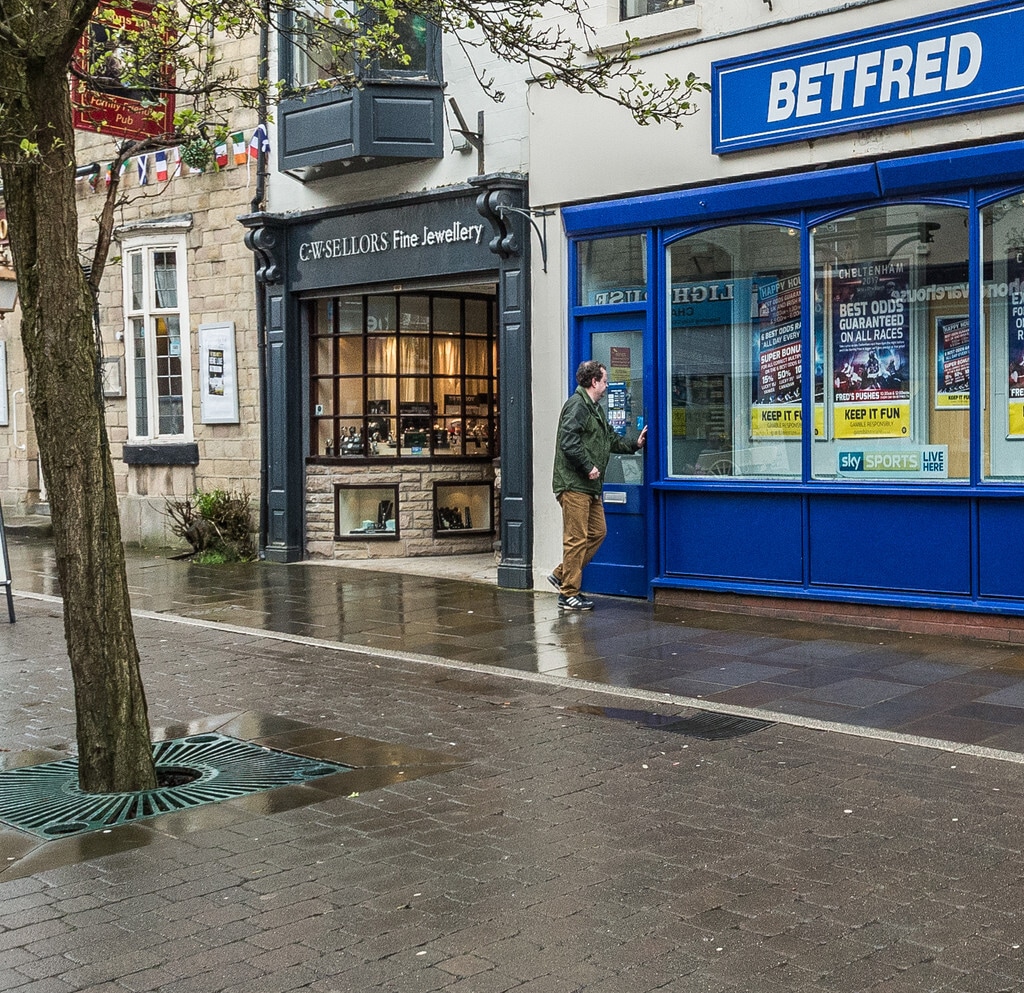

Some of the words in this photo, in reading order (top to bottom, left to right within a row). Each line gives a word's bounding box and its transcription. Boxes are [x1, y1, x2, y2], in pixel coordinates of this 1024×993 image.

[766, 31, 982, 123] BETFRED
[116, 113, 134, 125] Pub
[393, 230, 418, 250] Fine
[422, 221, 483, 246] Jewellery
[838, 263, 904, 279] CHELTENHAM
[862, 276, 878, 286] 2017
[840, 302, 868, 318] BEST
[871, 298, 904, 315] ODDS
[840, 314, 904, 330] GUARANTEED
[765, 328, 778, 340] BEST
[779, 325, 794, 335] ODDS
[783, 330, 800, 342] EVERY
[841, 331, 854, 342] ON
[856, 330, 872, 342] ALL
[874, 328, 904, 340] RACES
[761, 350, 780, 364] SUPER
[778, 370, 792, 380] 50%
[836, 392, 854, 401] FRED'S
[856, 391, 880, 400] PUSHES
[762, 411, 782, 421] KEEP
[784, 410, 792, 420] IT
[845, 409, 866, 420] KEEP
[870, 408, 878, 420] IT
[880, 408, 900, 419] FUN
[842, 453, 861, 470] sky
[866, 454, 918, 468] SPORTS
[923, 452, 944, 462] LIVE
[923, 462, 944, 472] HERE
